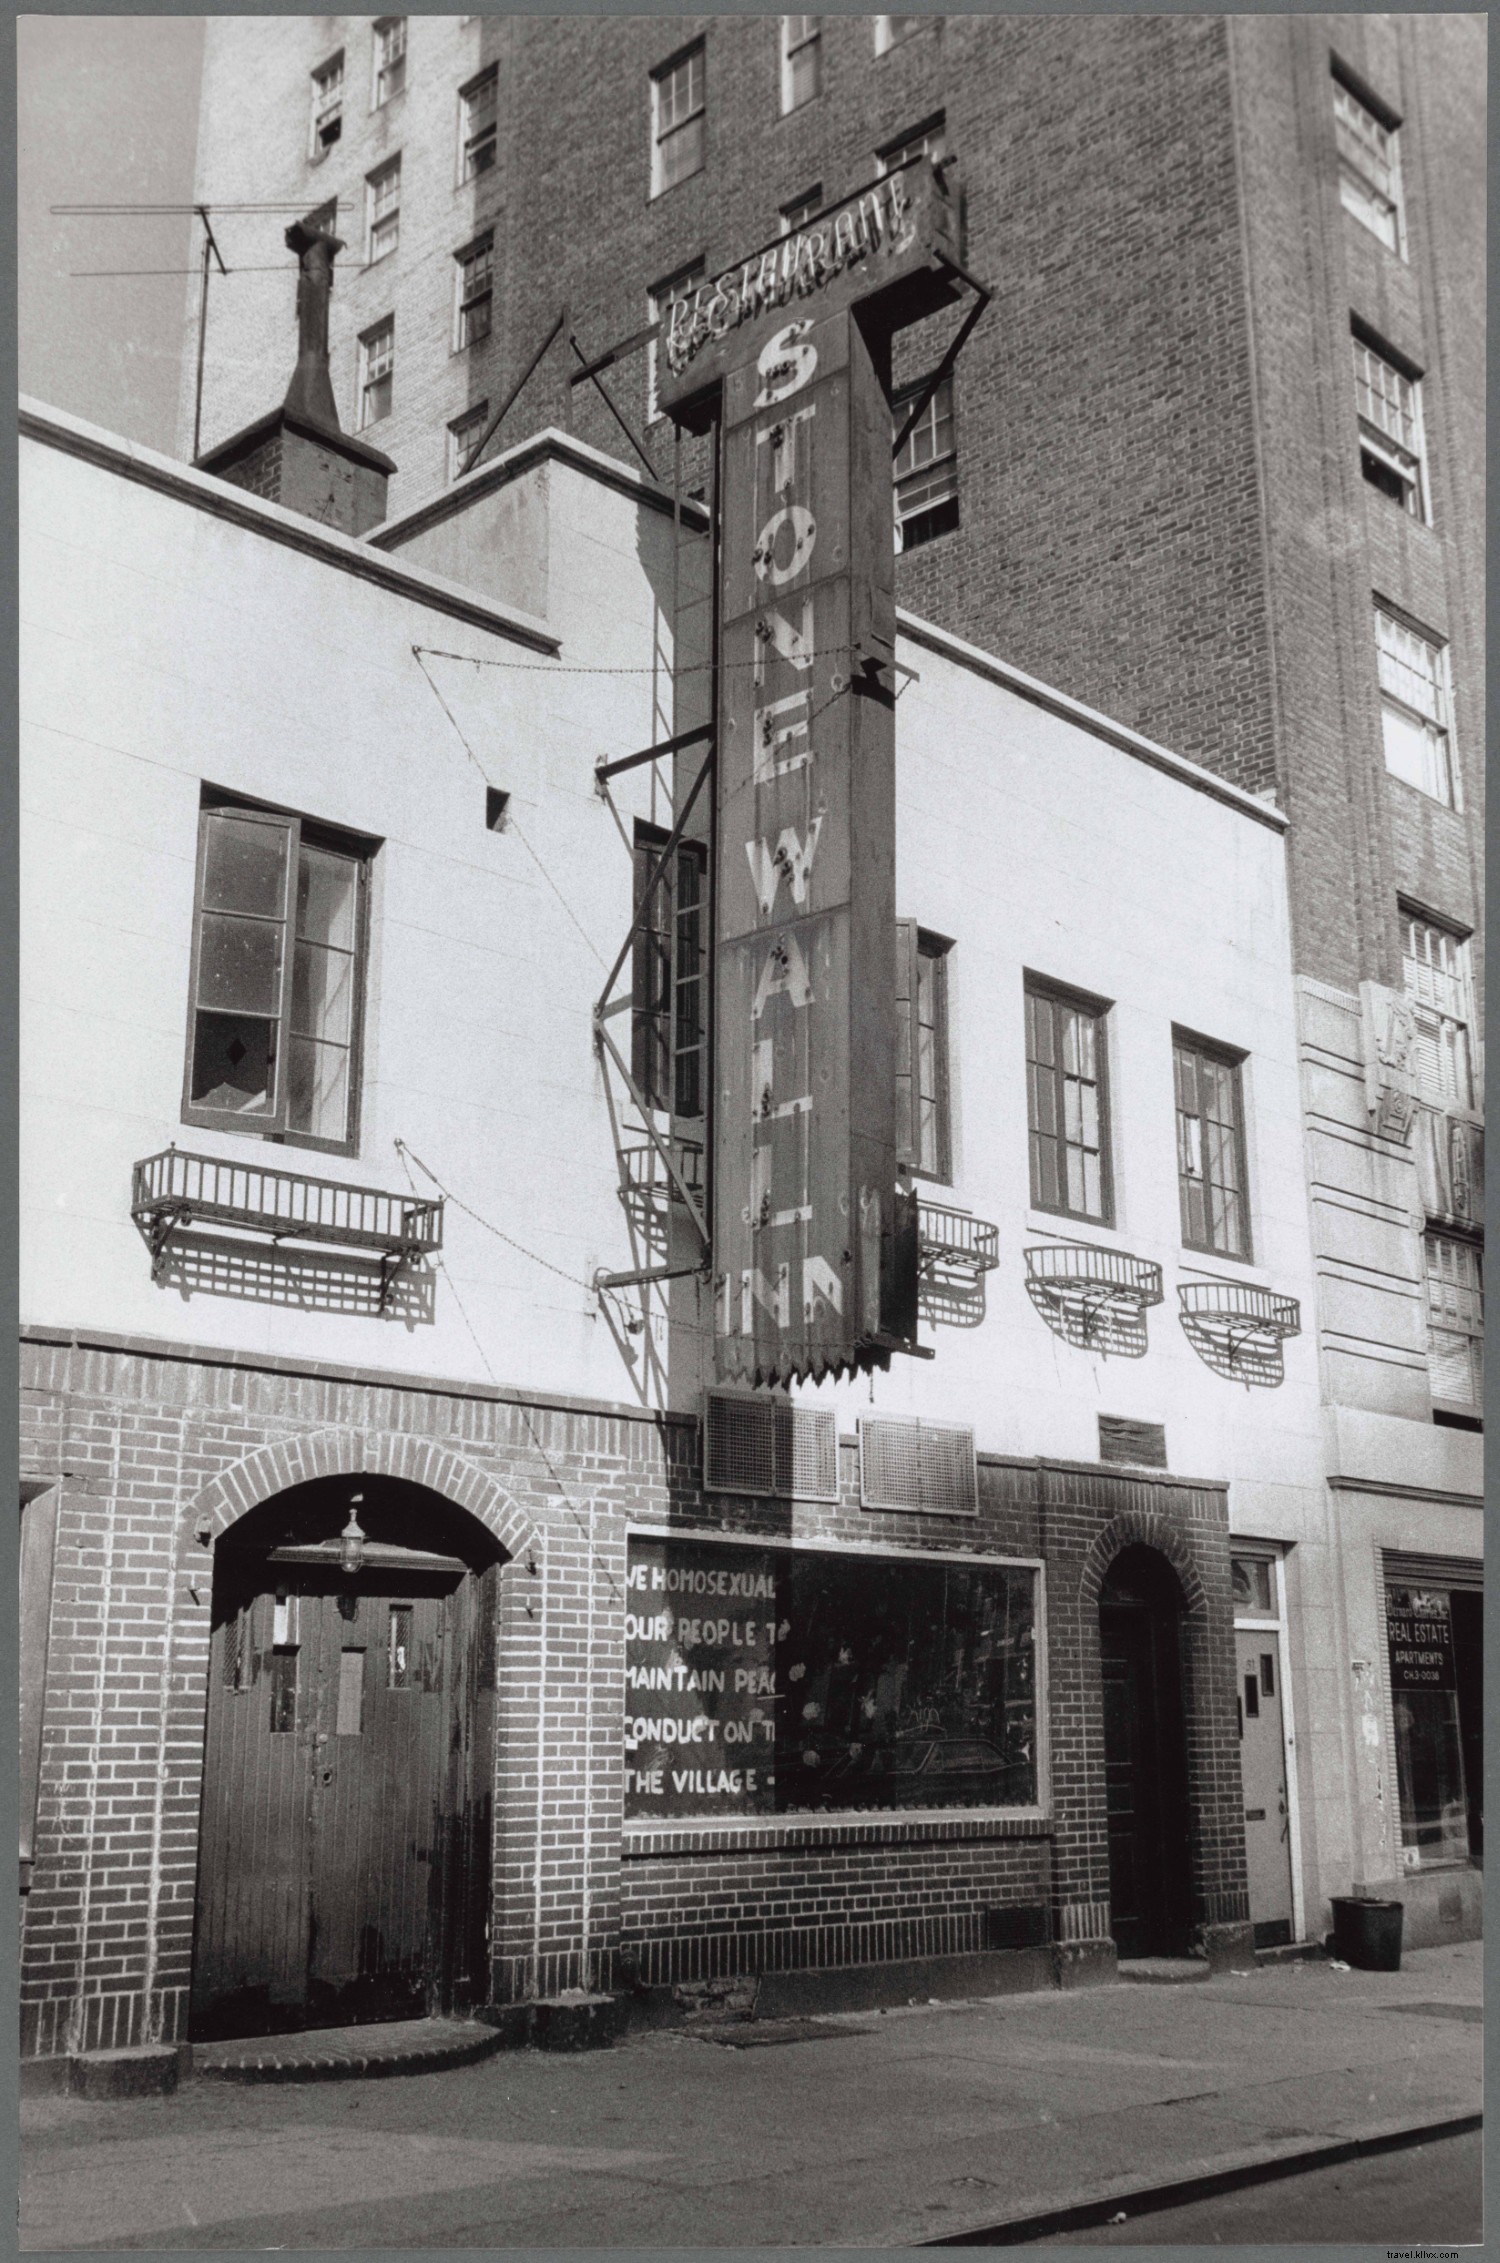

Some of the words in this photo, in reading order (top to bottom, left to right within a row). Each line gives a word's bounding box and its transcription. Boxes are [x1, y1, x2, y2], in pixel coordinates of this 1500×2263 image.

[744, 319, 823, 1229] STONEWALL
[716, 1255, 843, 1336] INN
[651, 1567, 776, 1599] HOMOSEXUAL
[624, 1613, 668, 1641] OUR
[678, 1617, 756, 1646] PEOPLE
[1388, 1622, 1412, 1642] REAL
[1415, 1624, 1449, 1644] ESTATE
[1395, 1651, 1444, 1666] APARTMENTS
[625, 1666, 725, 1693] MAINTAIN
[723, 1721, 753, 1743] ON
[624, 1769, 664, 1794] THE
[672, 1769, 758, 1793] VILLAGE
